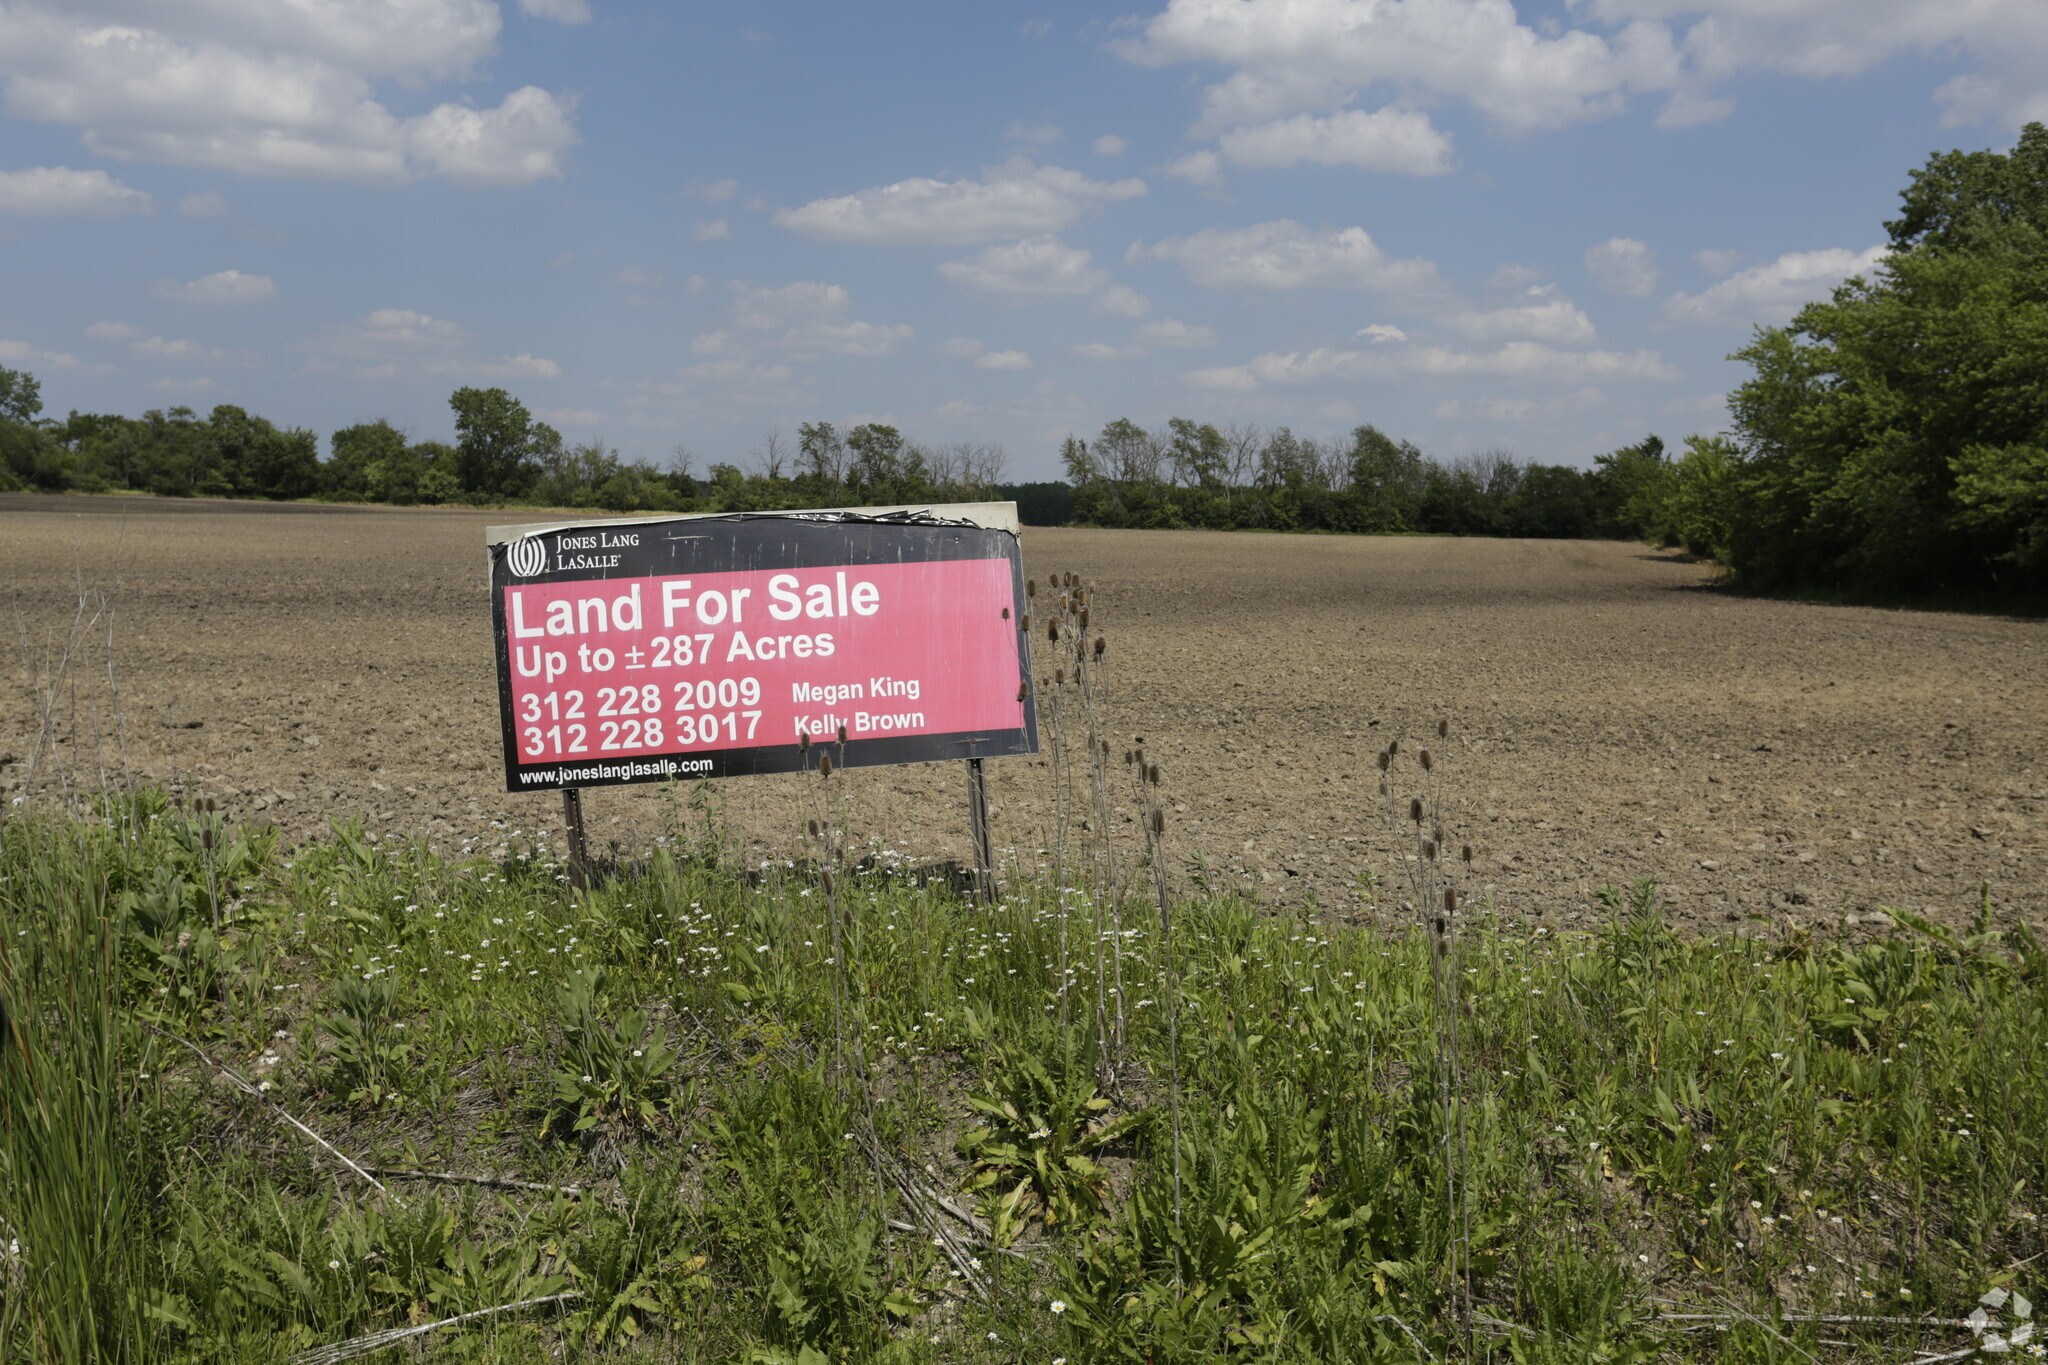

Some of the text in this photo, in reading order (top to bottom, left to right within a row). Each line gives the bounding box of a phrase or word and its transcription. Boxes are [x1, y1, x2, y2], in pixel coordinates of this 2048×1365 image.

[511, 571, 880, 639] Land For Sale
[516, 645, 567, 684] Up
[577, 642, 615, 673] to
[726, 630, 836, 663] Acres
[521, 676, 761, 723] 312 228 2009
[792, 677, 920, 706] Megan King
[524, 710, 763, 756] 312 228 3017
[854, 711, 925, 732] Brown
[519, 758, 713, 785] www.joneslanglasalle.com
